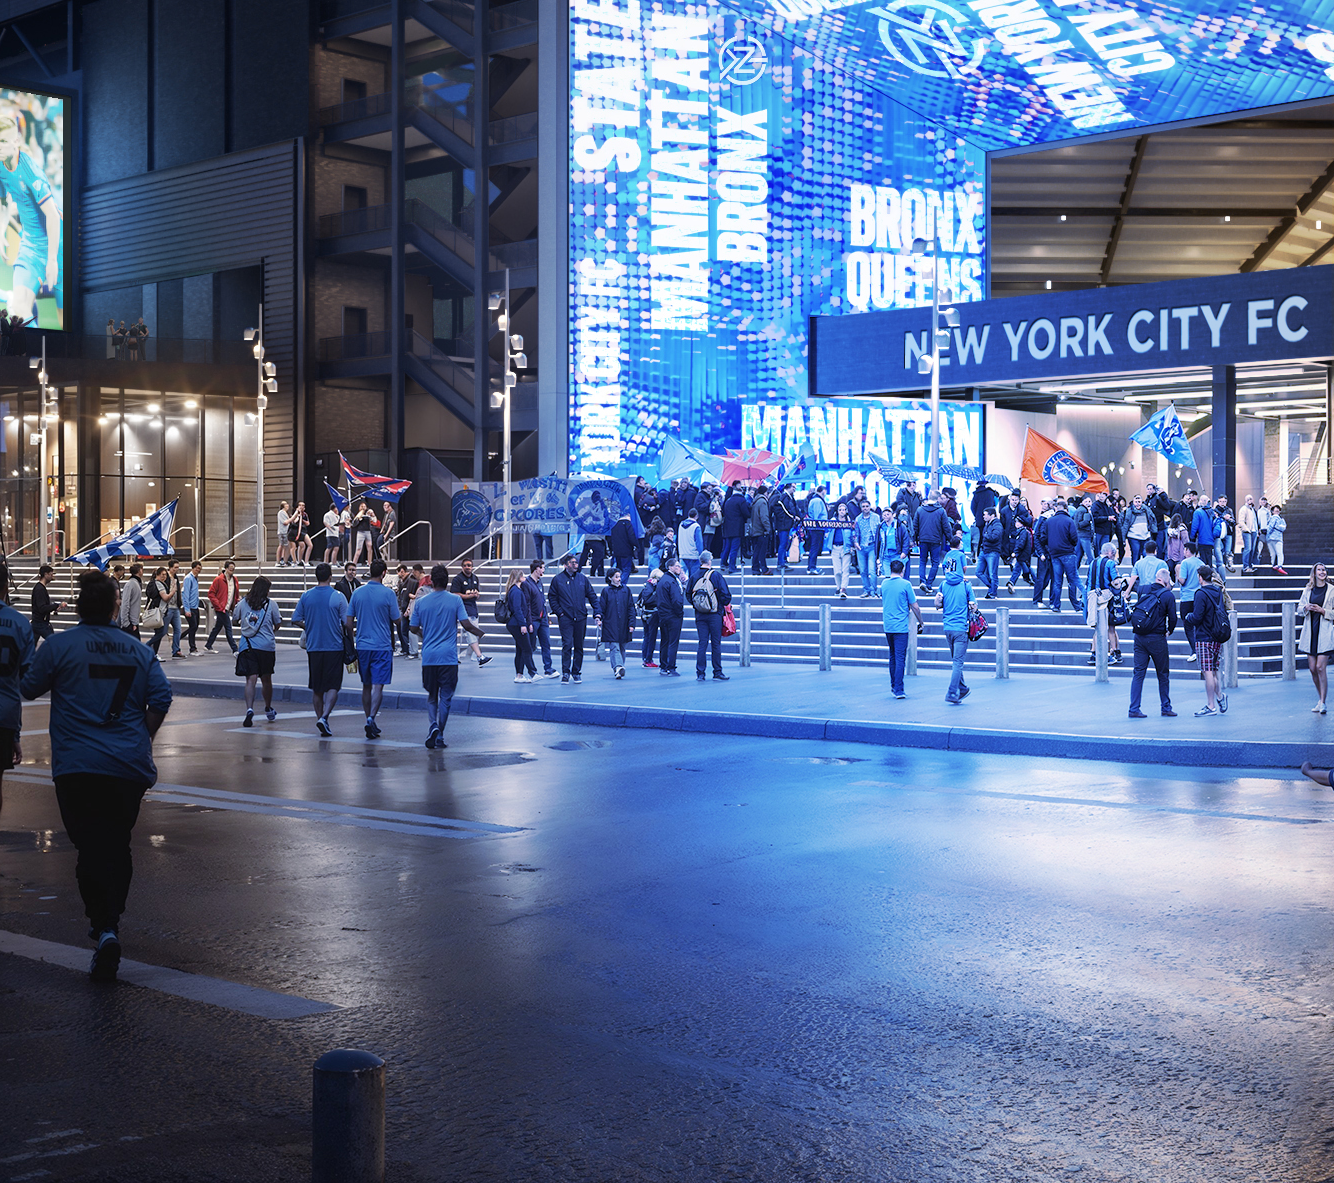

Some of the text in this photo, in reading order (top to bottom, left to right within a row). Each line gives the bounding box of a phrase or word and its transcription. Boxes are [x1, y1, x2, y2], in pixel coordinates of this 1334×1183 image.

[651, 14, 709, 332] MANHATTAN
[716, 106, 768, 263] BRONX
[850, 184, 981, 254] BRONX
[847, 251, 982, 312] QUEENS
[1002, 313, 1115, 362] YORK
[1126, 302, 1231, 354] CITY
[1248, 295, 1310, 345] FC
[741, 403, 981, 469] MANHATTAN
[88, 663, 138, 719] 7
